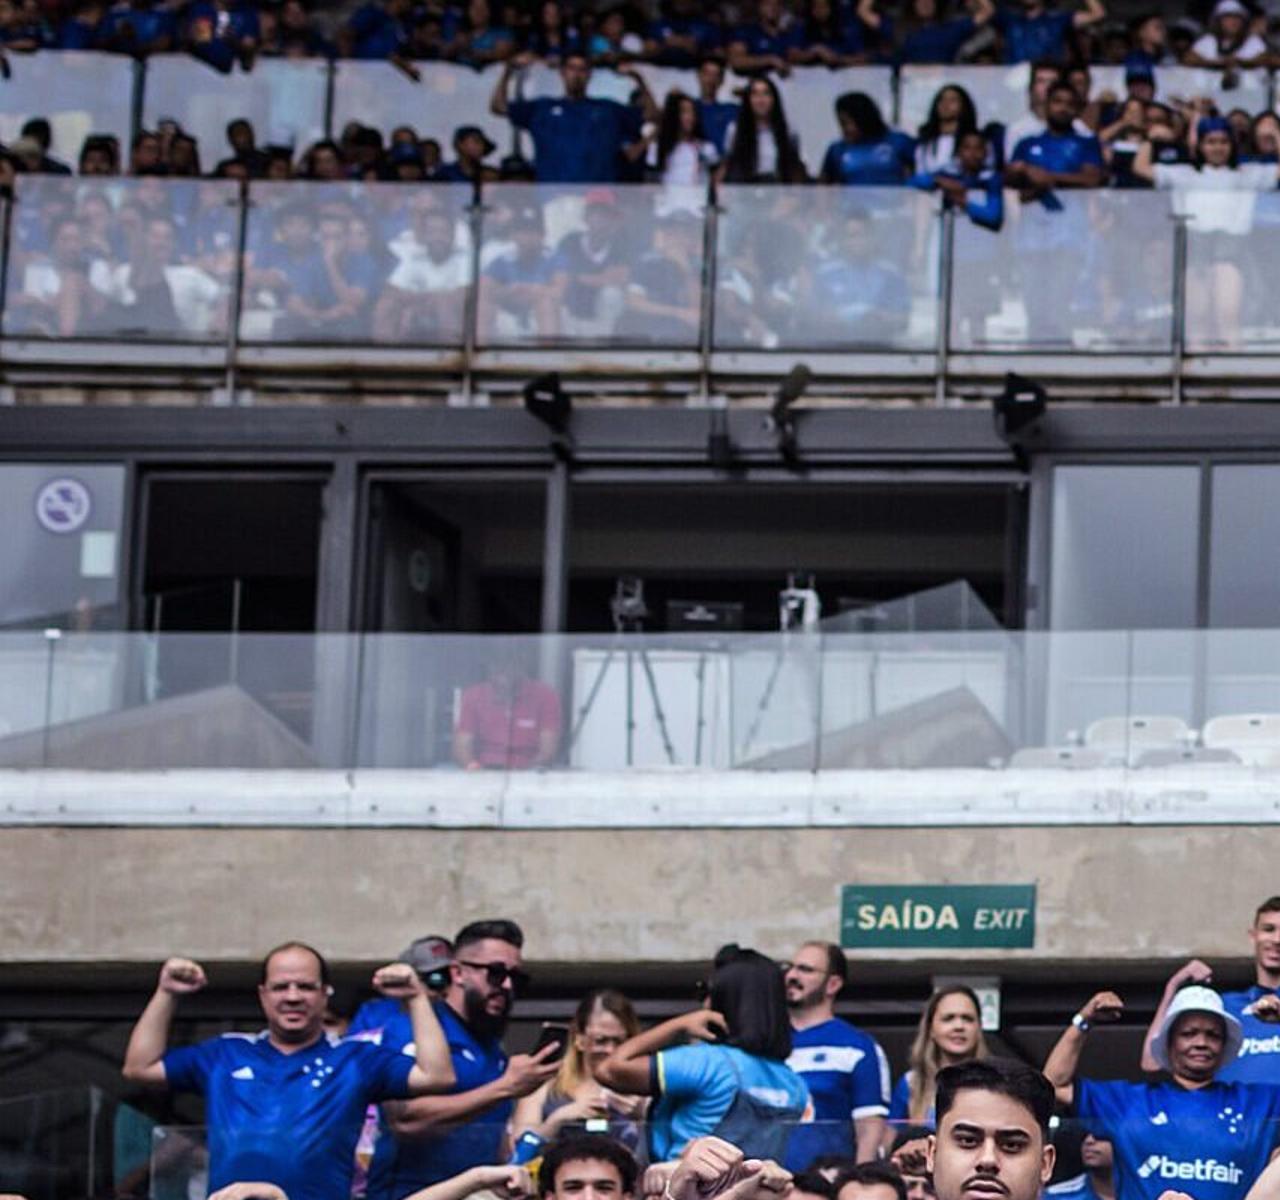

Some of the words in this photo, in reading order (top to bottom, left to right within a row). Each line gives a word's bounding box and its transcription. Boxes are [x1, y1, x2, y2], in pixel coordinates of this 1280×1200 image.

[858, 900, 959, 930] SAÍDA
[973, 909, 1028, 930] EXIT
[1159, 1156, 1244, 1184] betfair
